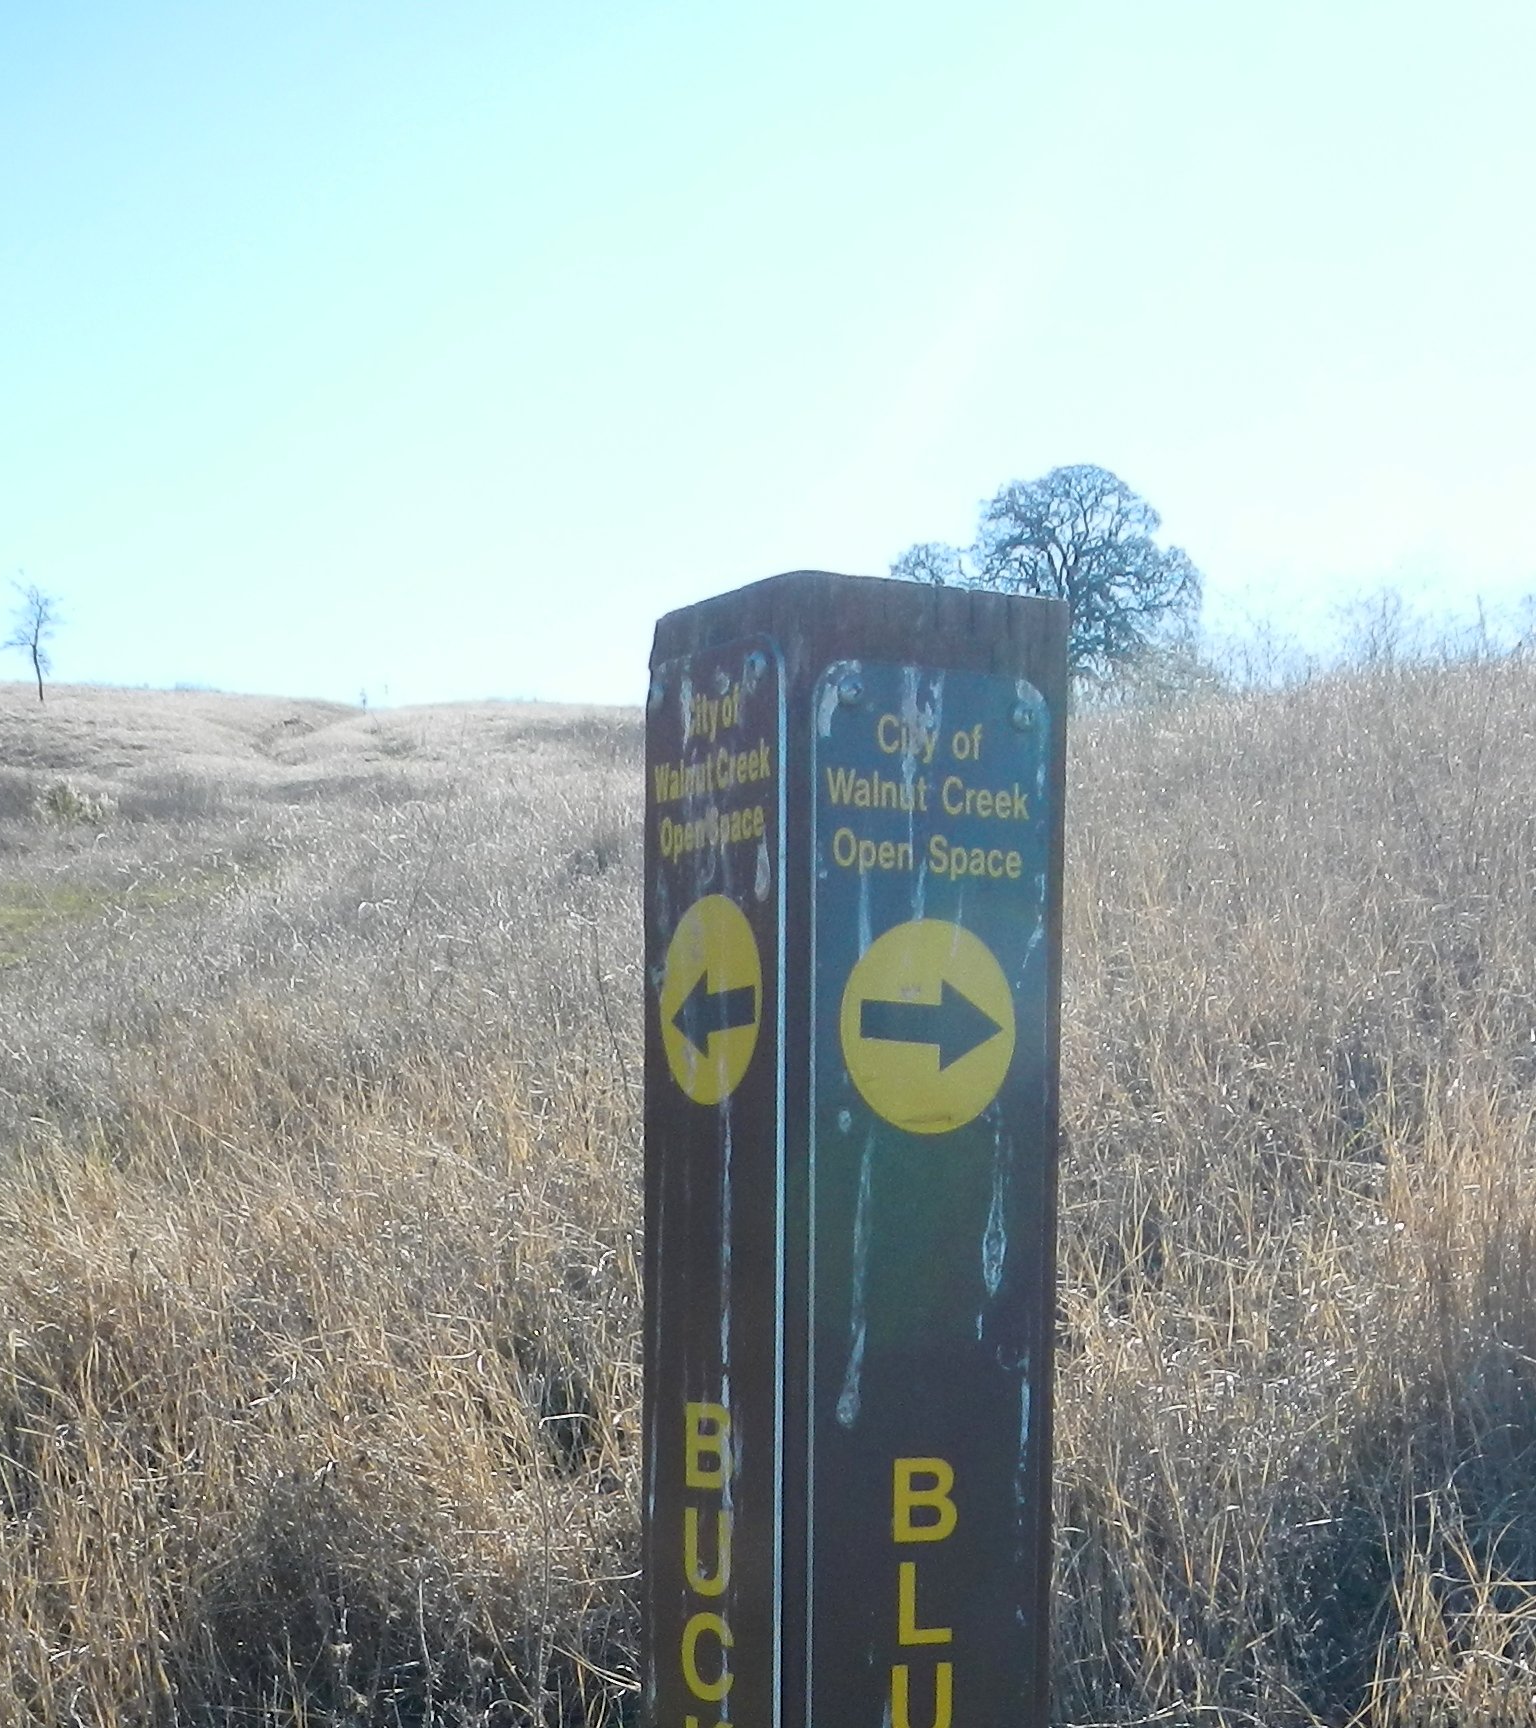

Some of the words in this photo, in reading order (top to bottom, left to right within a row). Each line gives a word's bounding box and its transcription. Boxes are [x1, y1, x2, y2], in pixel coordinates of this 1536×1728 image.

[722, 682, 740, 728] of
[952, 723, 982, 760] of
[655, 753, 714, 803] Walnut
[716, 738, 771, 789] Creek
[827, 767, 928, 812] Walnut
[943, 775, 1029, 820] Creek
[660, 817, 705, 864] Open
[833, 827, 913, 874] Open
[929, 834, 1022, 881] Space
